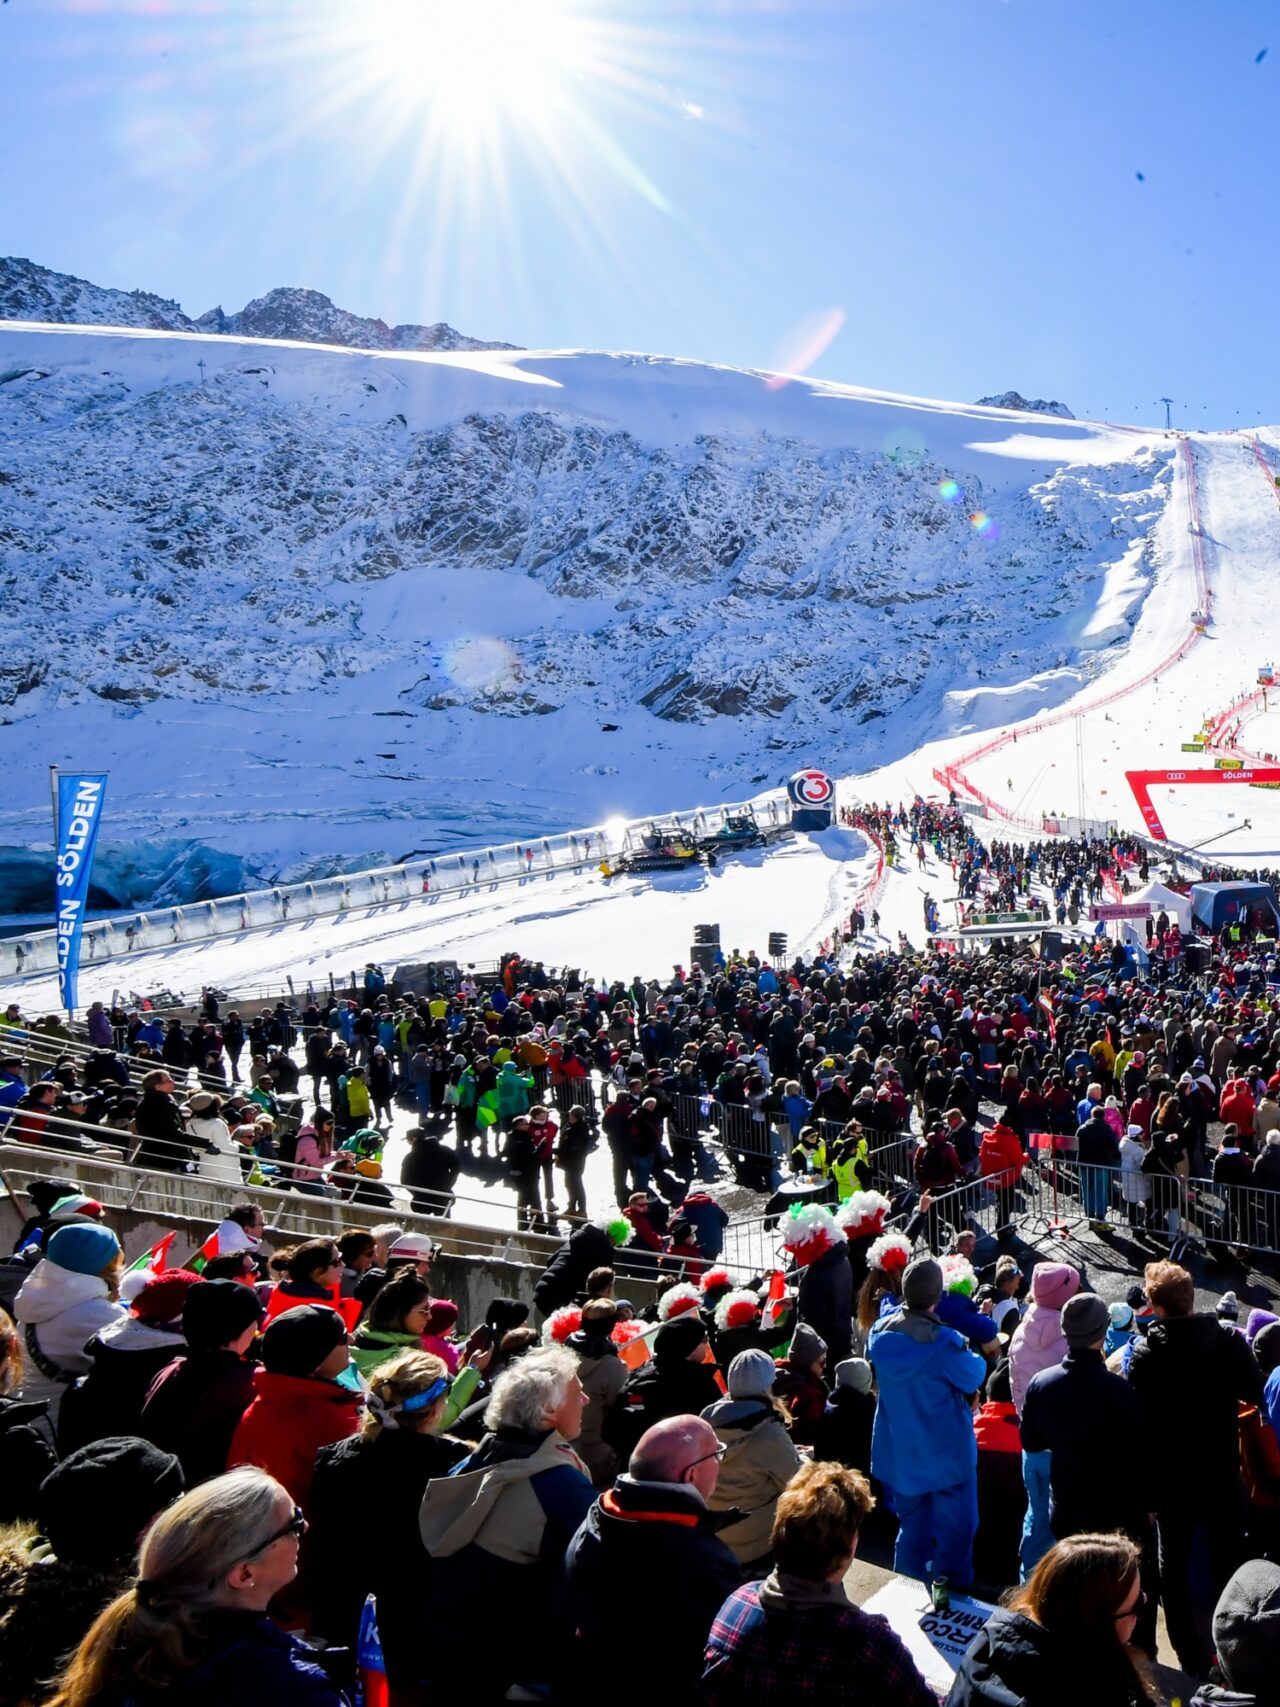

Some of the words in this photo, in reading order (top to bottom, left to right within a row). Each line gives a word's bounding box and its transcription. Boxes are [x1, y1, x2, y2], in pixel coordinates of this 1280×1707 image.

[1222, 771, 1253, 779] SÖLDEN
[56, 780, 102, 888] SÖLDEN
[1101, 908, 1128, 917] SPECIAL
[1128, 907, 1149, 915] GUEST
[57, 899, 82, 1008] LDEN
[919, 1619, 977, 1646] RCO
[932, 1640, 967, 1656] ANCLUB
